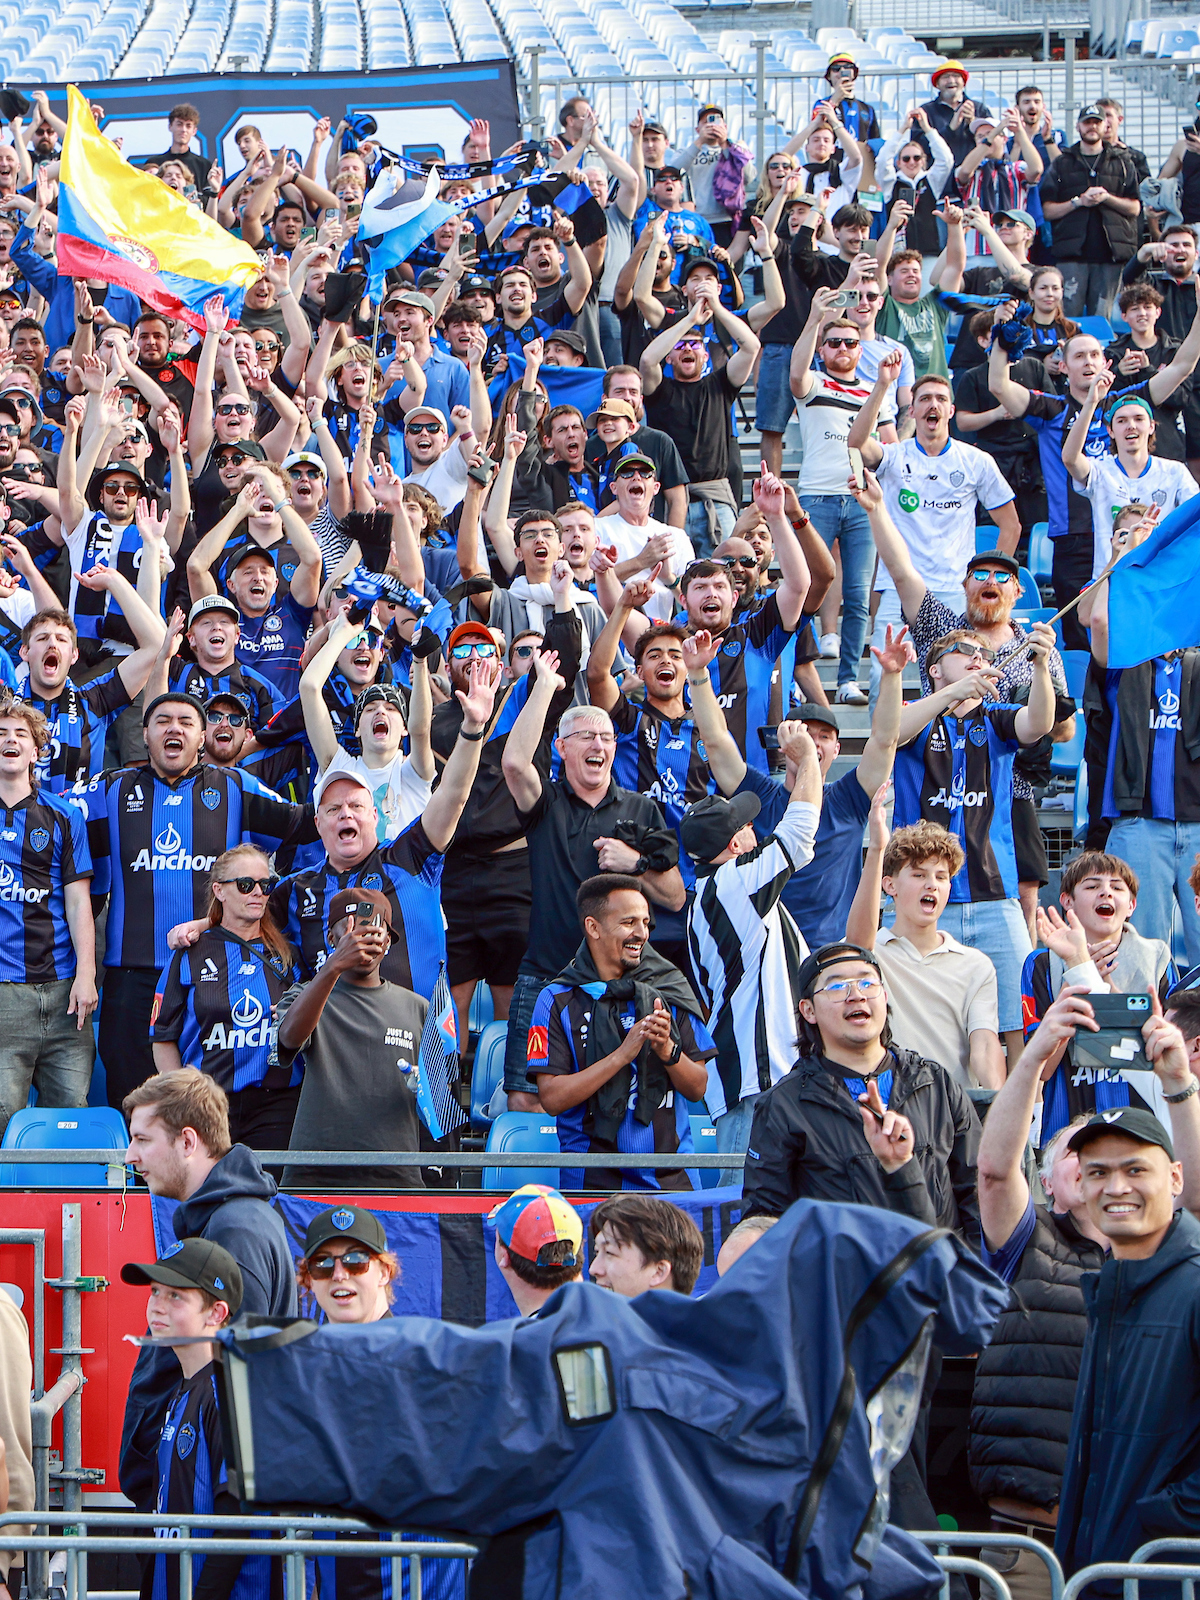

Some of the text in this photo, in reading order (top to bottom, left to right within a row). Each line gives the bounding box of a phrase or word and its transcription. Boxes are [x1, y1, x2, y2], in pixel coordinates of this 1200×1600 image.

[901, 493, 919, 508] GO
[263, 643, 286, 653] TYRES
[130, 848, 218, 872] Anchor
[386, 1027, 413, 1040] JUST DO
[385, 1036, 414, 1050] NOTHING
